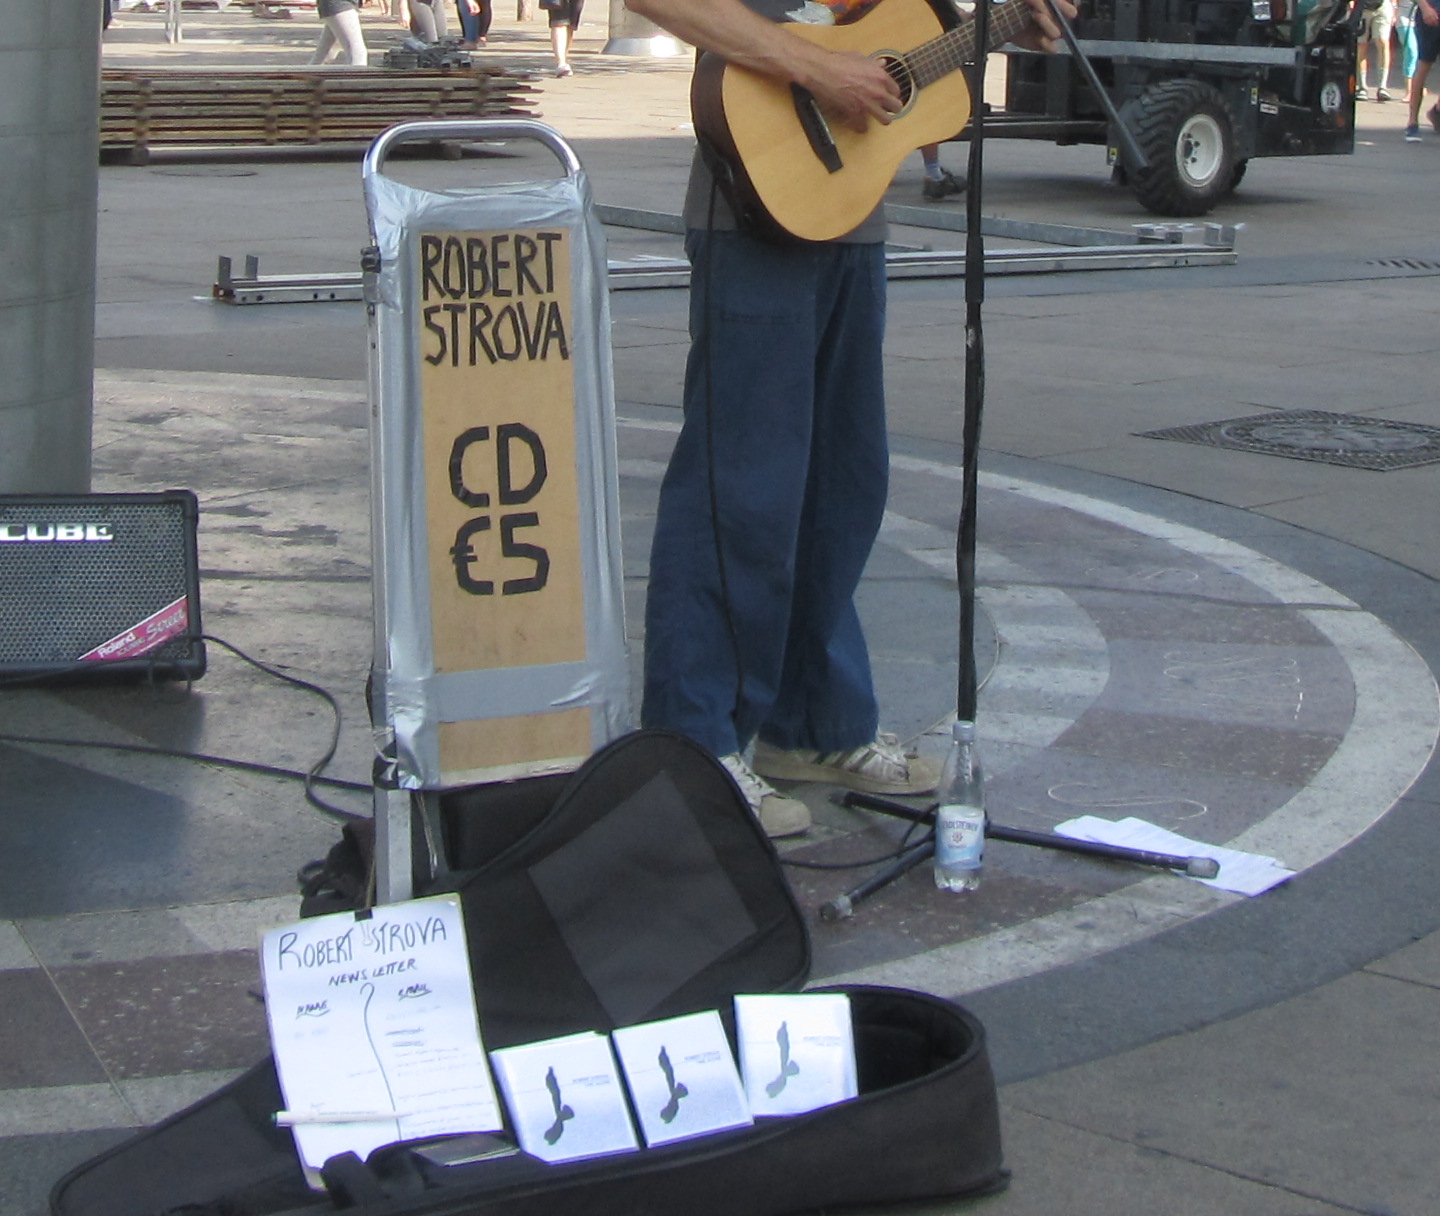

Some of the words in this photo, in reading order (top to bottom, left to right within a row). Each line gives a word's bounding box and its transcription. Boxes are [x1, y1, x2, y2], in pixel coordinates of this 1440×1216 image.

[421, 233, 562, 300] ROBERT
[425, 302, 569, 367] STROVA
[449, 422, 548, 508] CD
[449, 512, 550, 596] €5
[97, 631, 137, 658] Roland
[277, 928, 355, 970] ROBERT
[371, 916, 447, 956] STROVA
